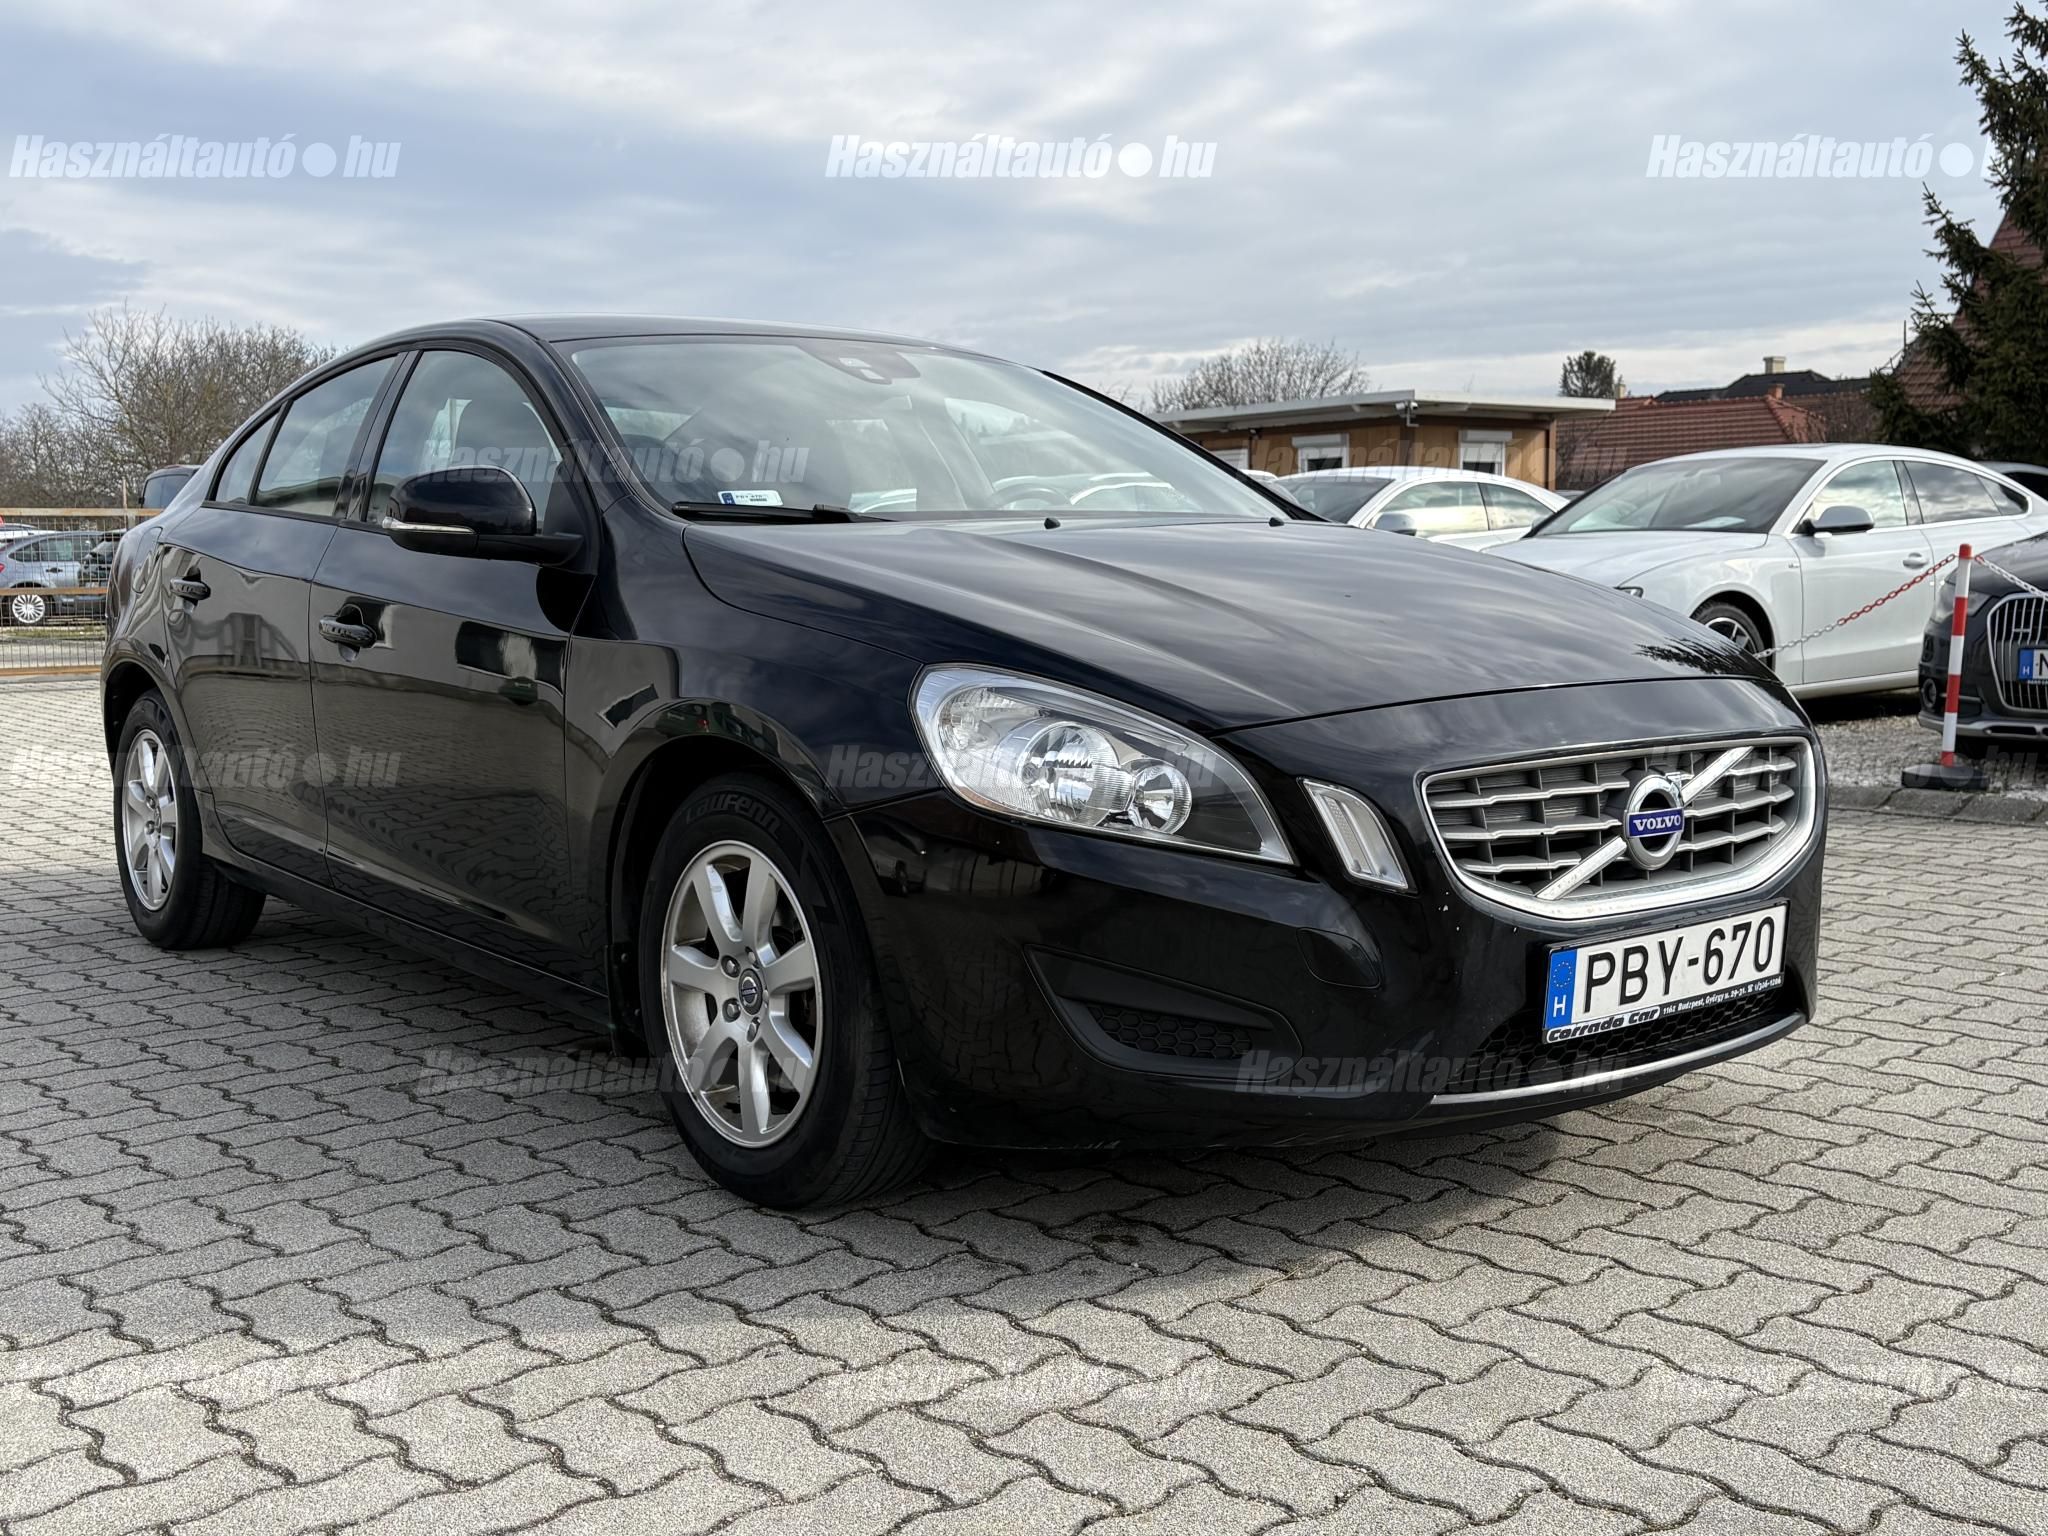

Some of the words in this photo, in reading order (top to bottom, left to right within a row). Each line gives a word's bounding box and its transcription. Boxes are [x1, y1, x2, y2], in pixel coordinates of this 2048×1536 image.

[1633, 814, 1682, 831] VOLVO
[1583, 916, 1776, 1014] PBY-670
[1553, 994, 1567, 1018] H
[1548, 1017, 1625, 1042] Corrado
[1628, 1008, 1660, 1025] Car
